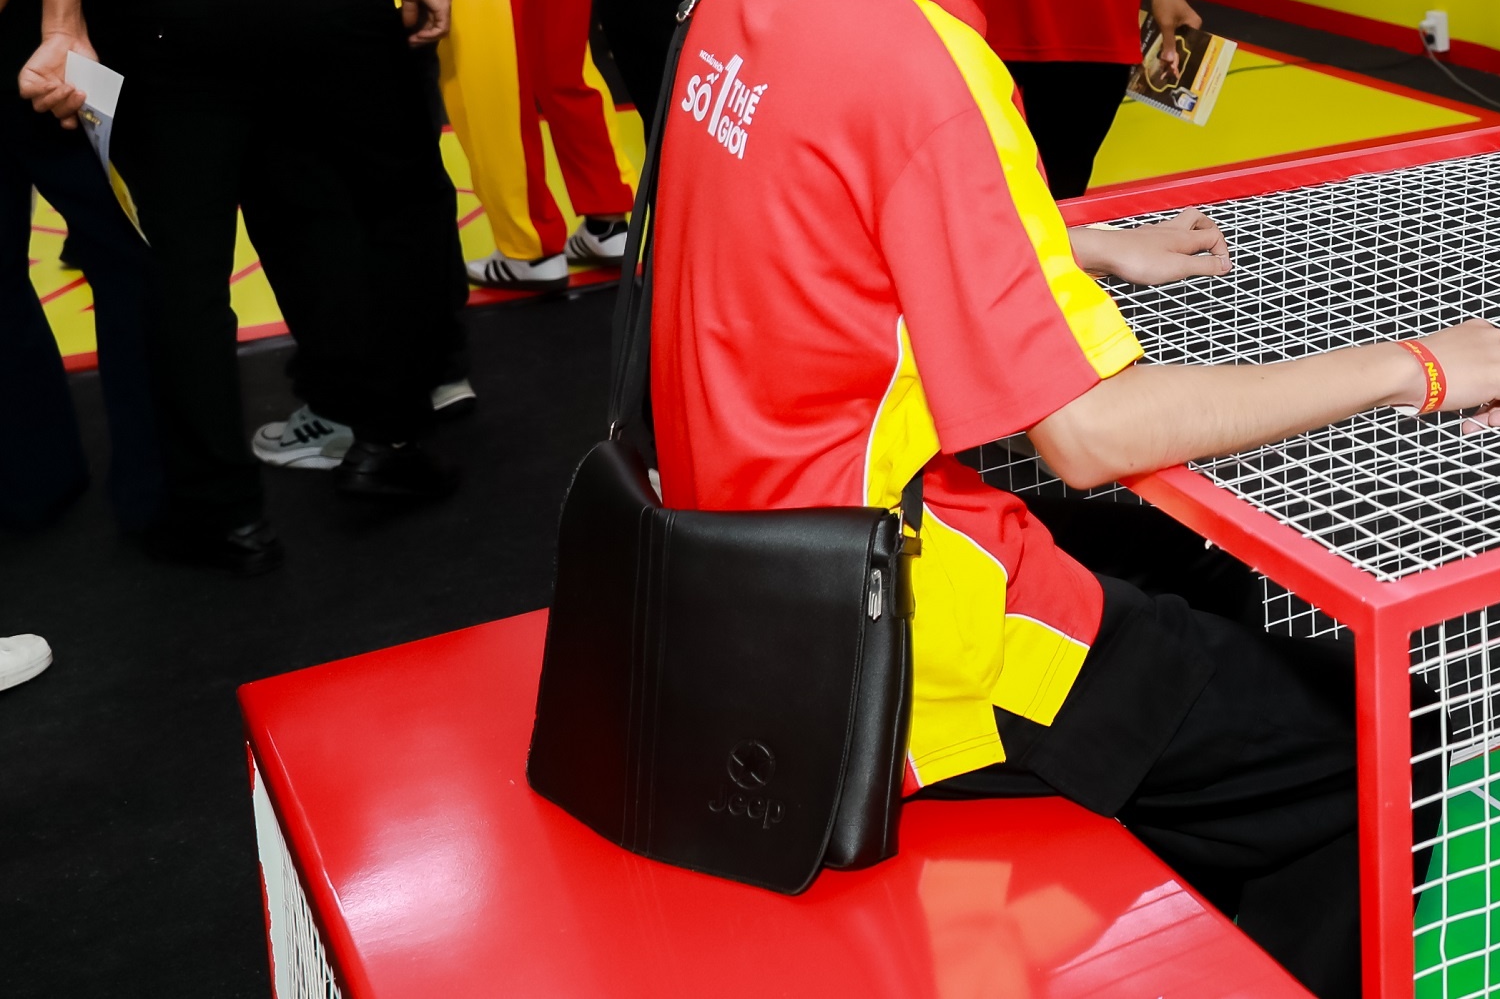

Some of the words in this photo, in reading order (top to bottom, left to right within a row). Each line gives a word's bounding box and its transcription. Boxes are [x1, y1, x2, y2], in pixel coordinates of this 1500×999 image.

[682, 73, 720, 121] SỐ
[707, 54, 744, 137] 1
[728, 78, 768, 125] THẾ
[717, 116, 748, 160] GIỚI
[1425, 361, 1442, 396] Nhất
